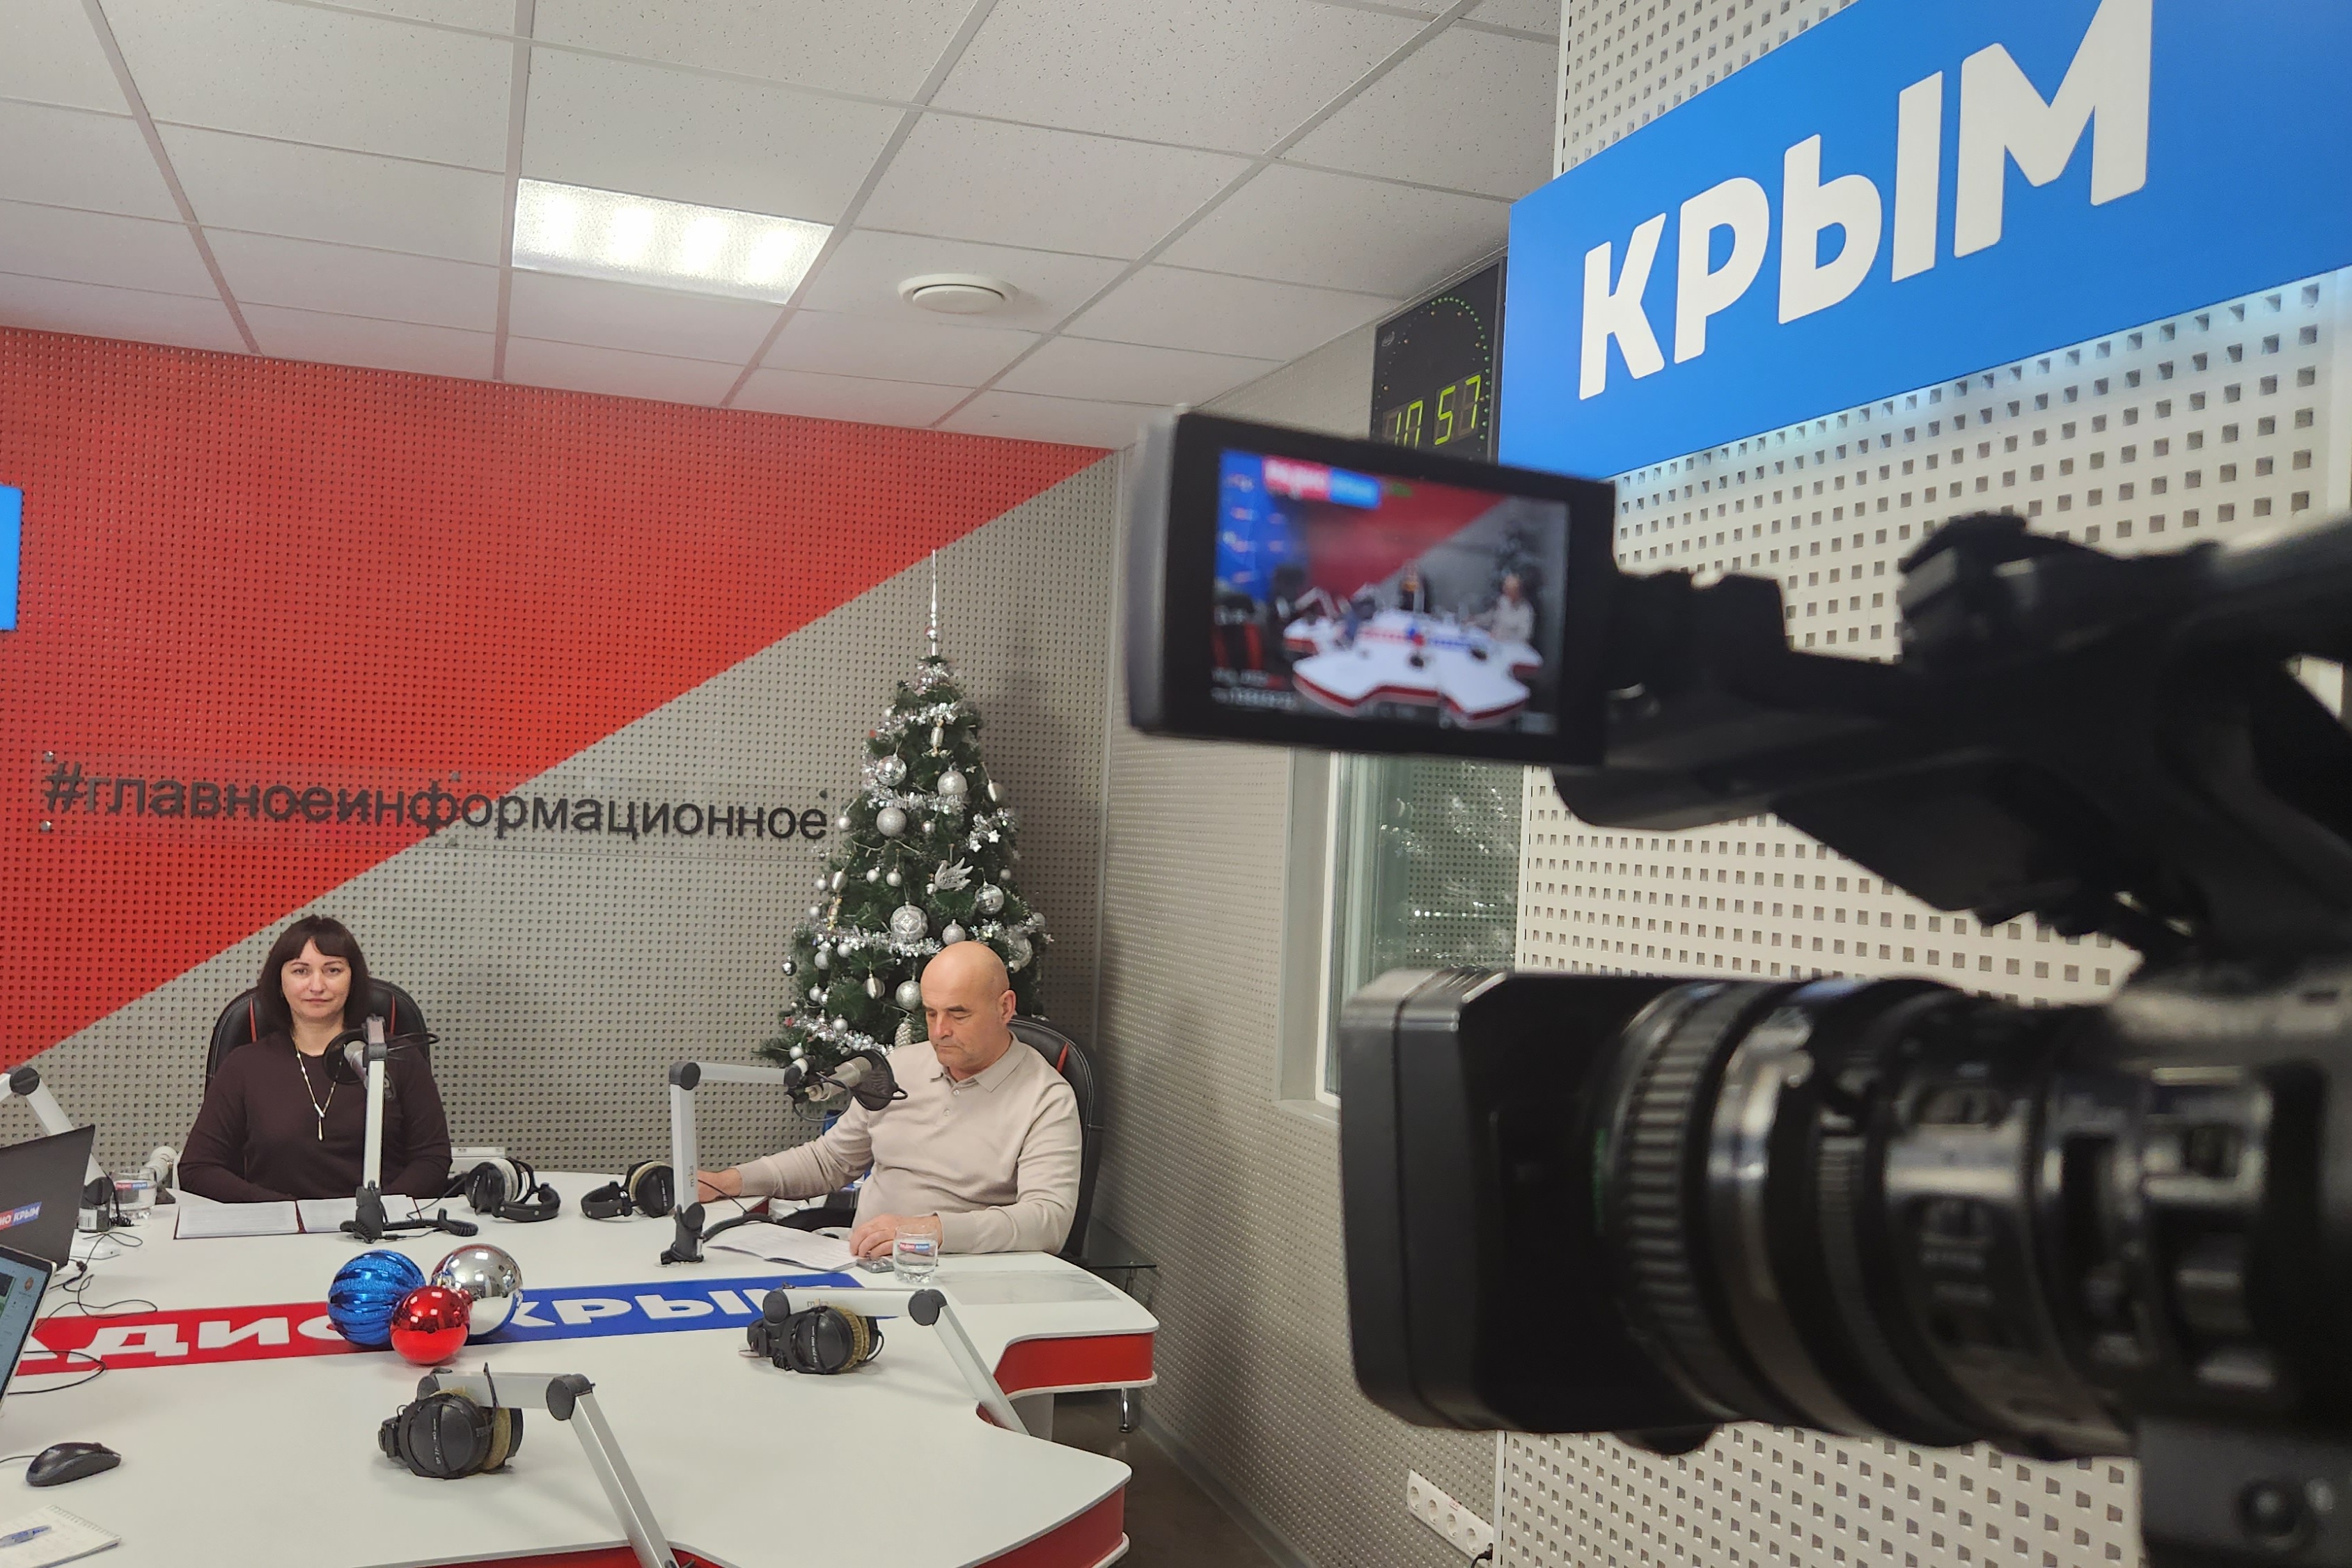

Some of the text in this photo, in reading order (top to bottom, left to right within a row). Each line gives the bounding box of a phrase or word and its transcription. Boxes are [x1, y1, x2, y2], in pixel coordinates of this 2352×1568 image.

[1578, 0, 2154, 400] КРЫМ
[1434, 374, 1482, 446] 57
[43, 760, 829, 841] #главноеинформационное
